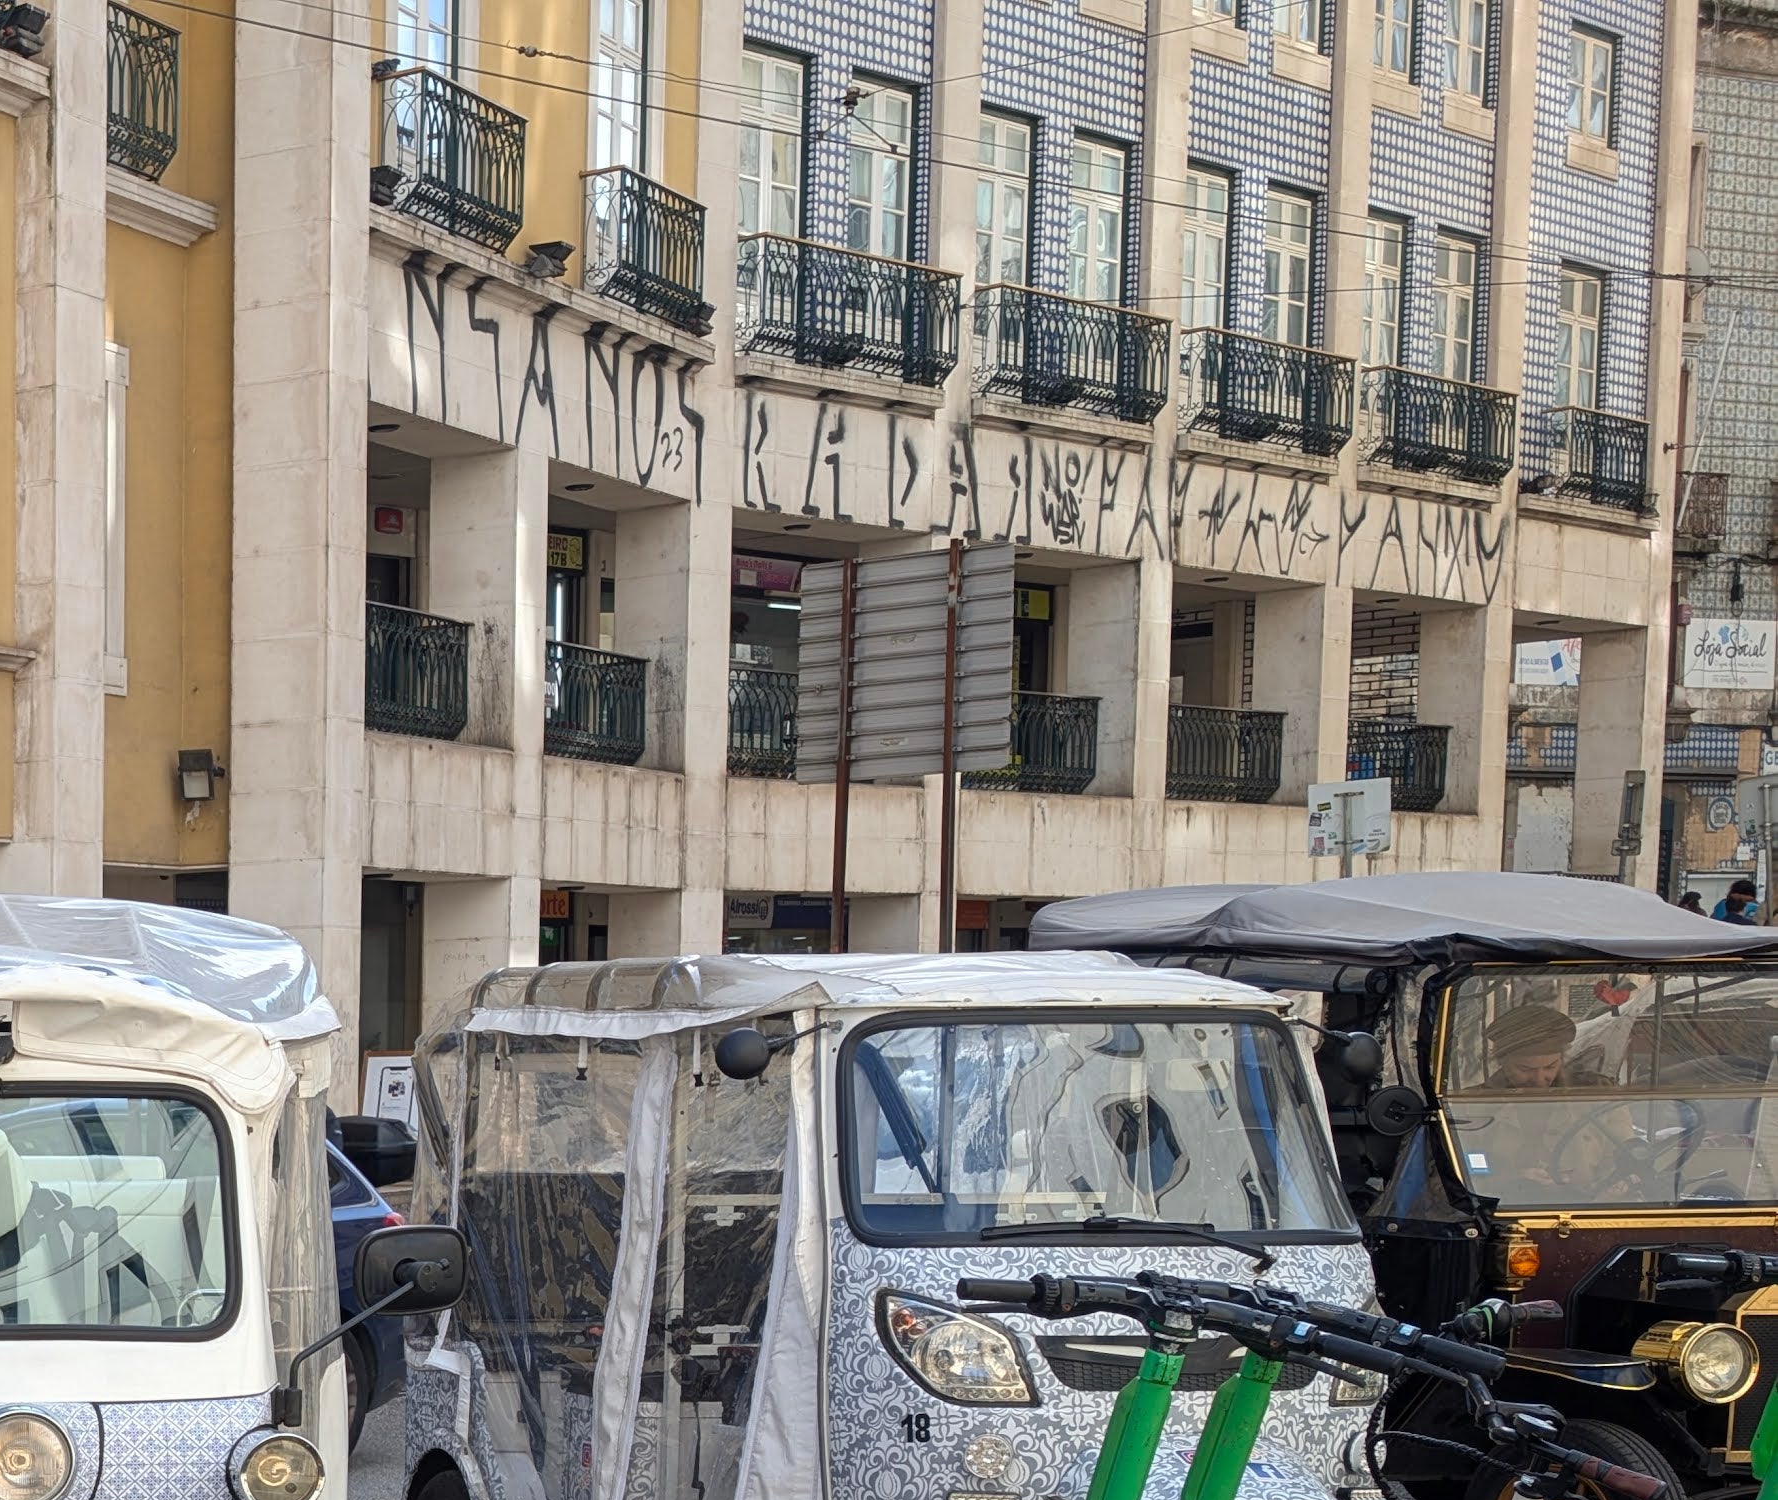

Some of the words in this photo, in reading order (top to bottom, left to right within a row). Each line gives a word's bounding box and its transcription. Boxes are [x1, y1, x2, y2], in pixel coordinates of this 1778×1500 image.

[1694, 630, 1723, 666] Loja
[1725, 631, 1767, 659] Social
[901, 1413, 931, 1443] 18
